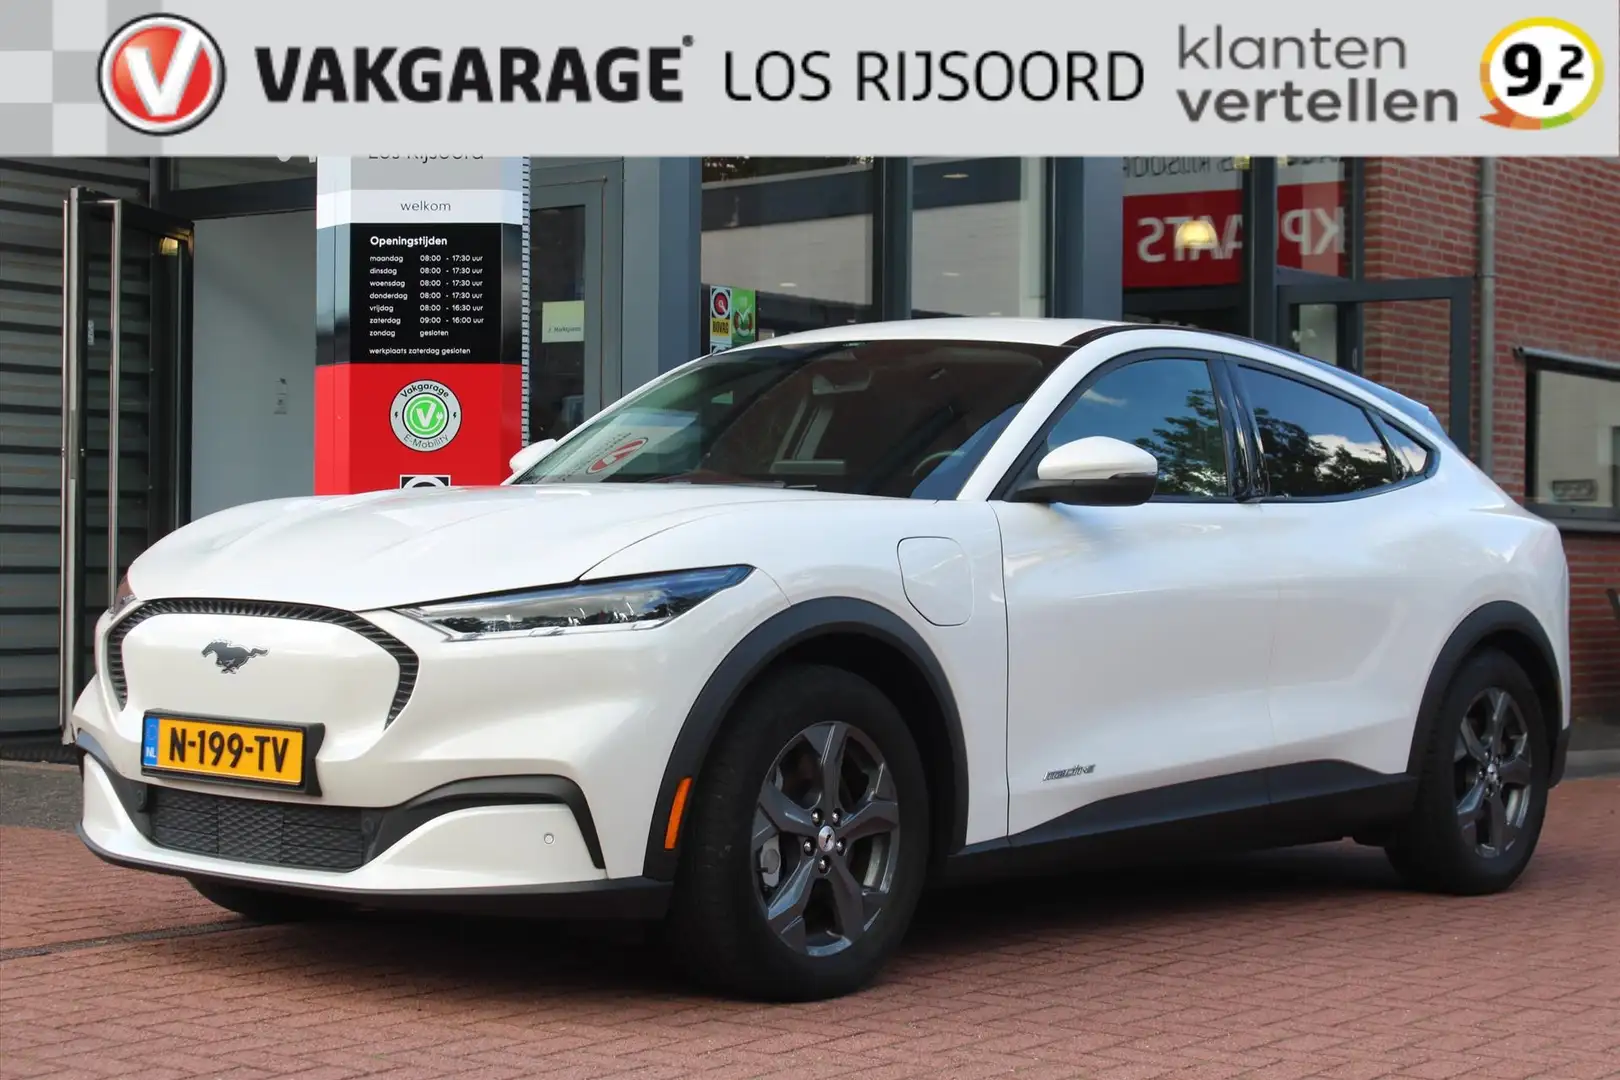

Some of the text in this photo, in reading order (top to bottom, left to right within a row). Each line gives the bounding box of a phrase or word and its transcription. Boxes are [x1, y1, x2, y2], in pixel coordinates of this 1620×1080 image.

[400, 200, 452, 212] welkom
[369, 236, 448, 248] Openingstijden
[369, 254, 403, 263] maandag
[419, 254, 442, 262] 08:00
[452, 254, 470, 262] 17:30
[369, 267, 397, 276] dinsdag
[419, 267, 442, 275] 08:00
[452, 267, 470, 275] 17:30
[369, 279, 405, 288] woensdag
[419, 279, 442, 287] 08:00
[452, 279, 470, 287] 17:30
[369, 292, 408, 301] donderdag
[419, 292, 442, 300] 08:00
[452, 292, 470, 300] 17:30
[369, 304, 394, 313] vrijdag
[419, 304, 442, 312] 08:00
[452, 304, 471, 312] 16:30
[369, 316, 401, 325] zaterdag
[419, 316, 442, 324] 09:00
[452, 316, 471, 324] 16:00
[369, 329, 449, 338] zondag gesloten
[369, 347, 471, 356] werkplaats zaterdag gesloten
[400, 383, 449, 398] Vakgarage
[403, 433, 449, 449] E-Mobility
[145, 746, 157, 759] NL
[169, 727, 289, 773] N-199-TV
